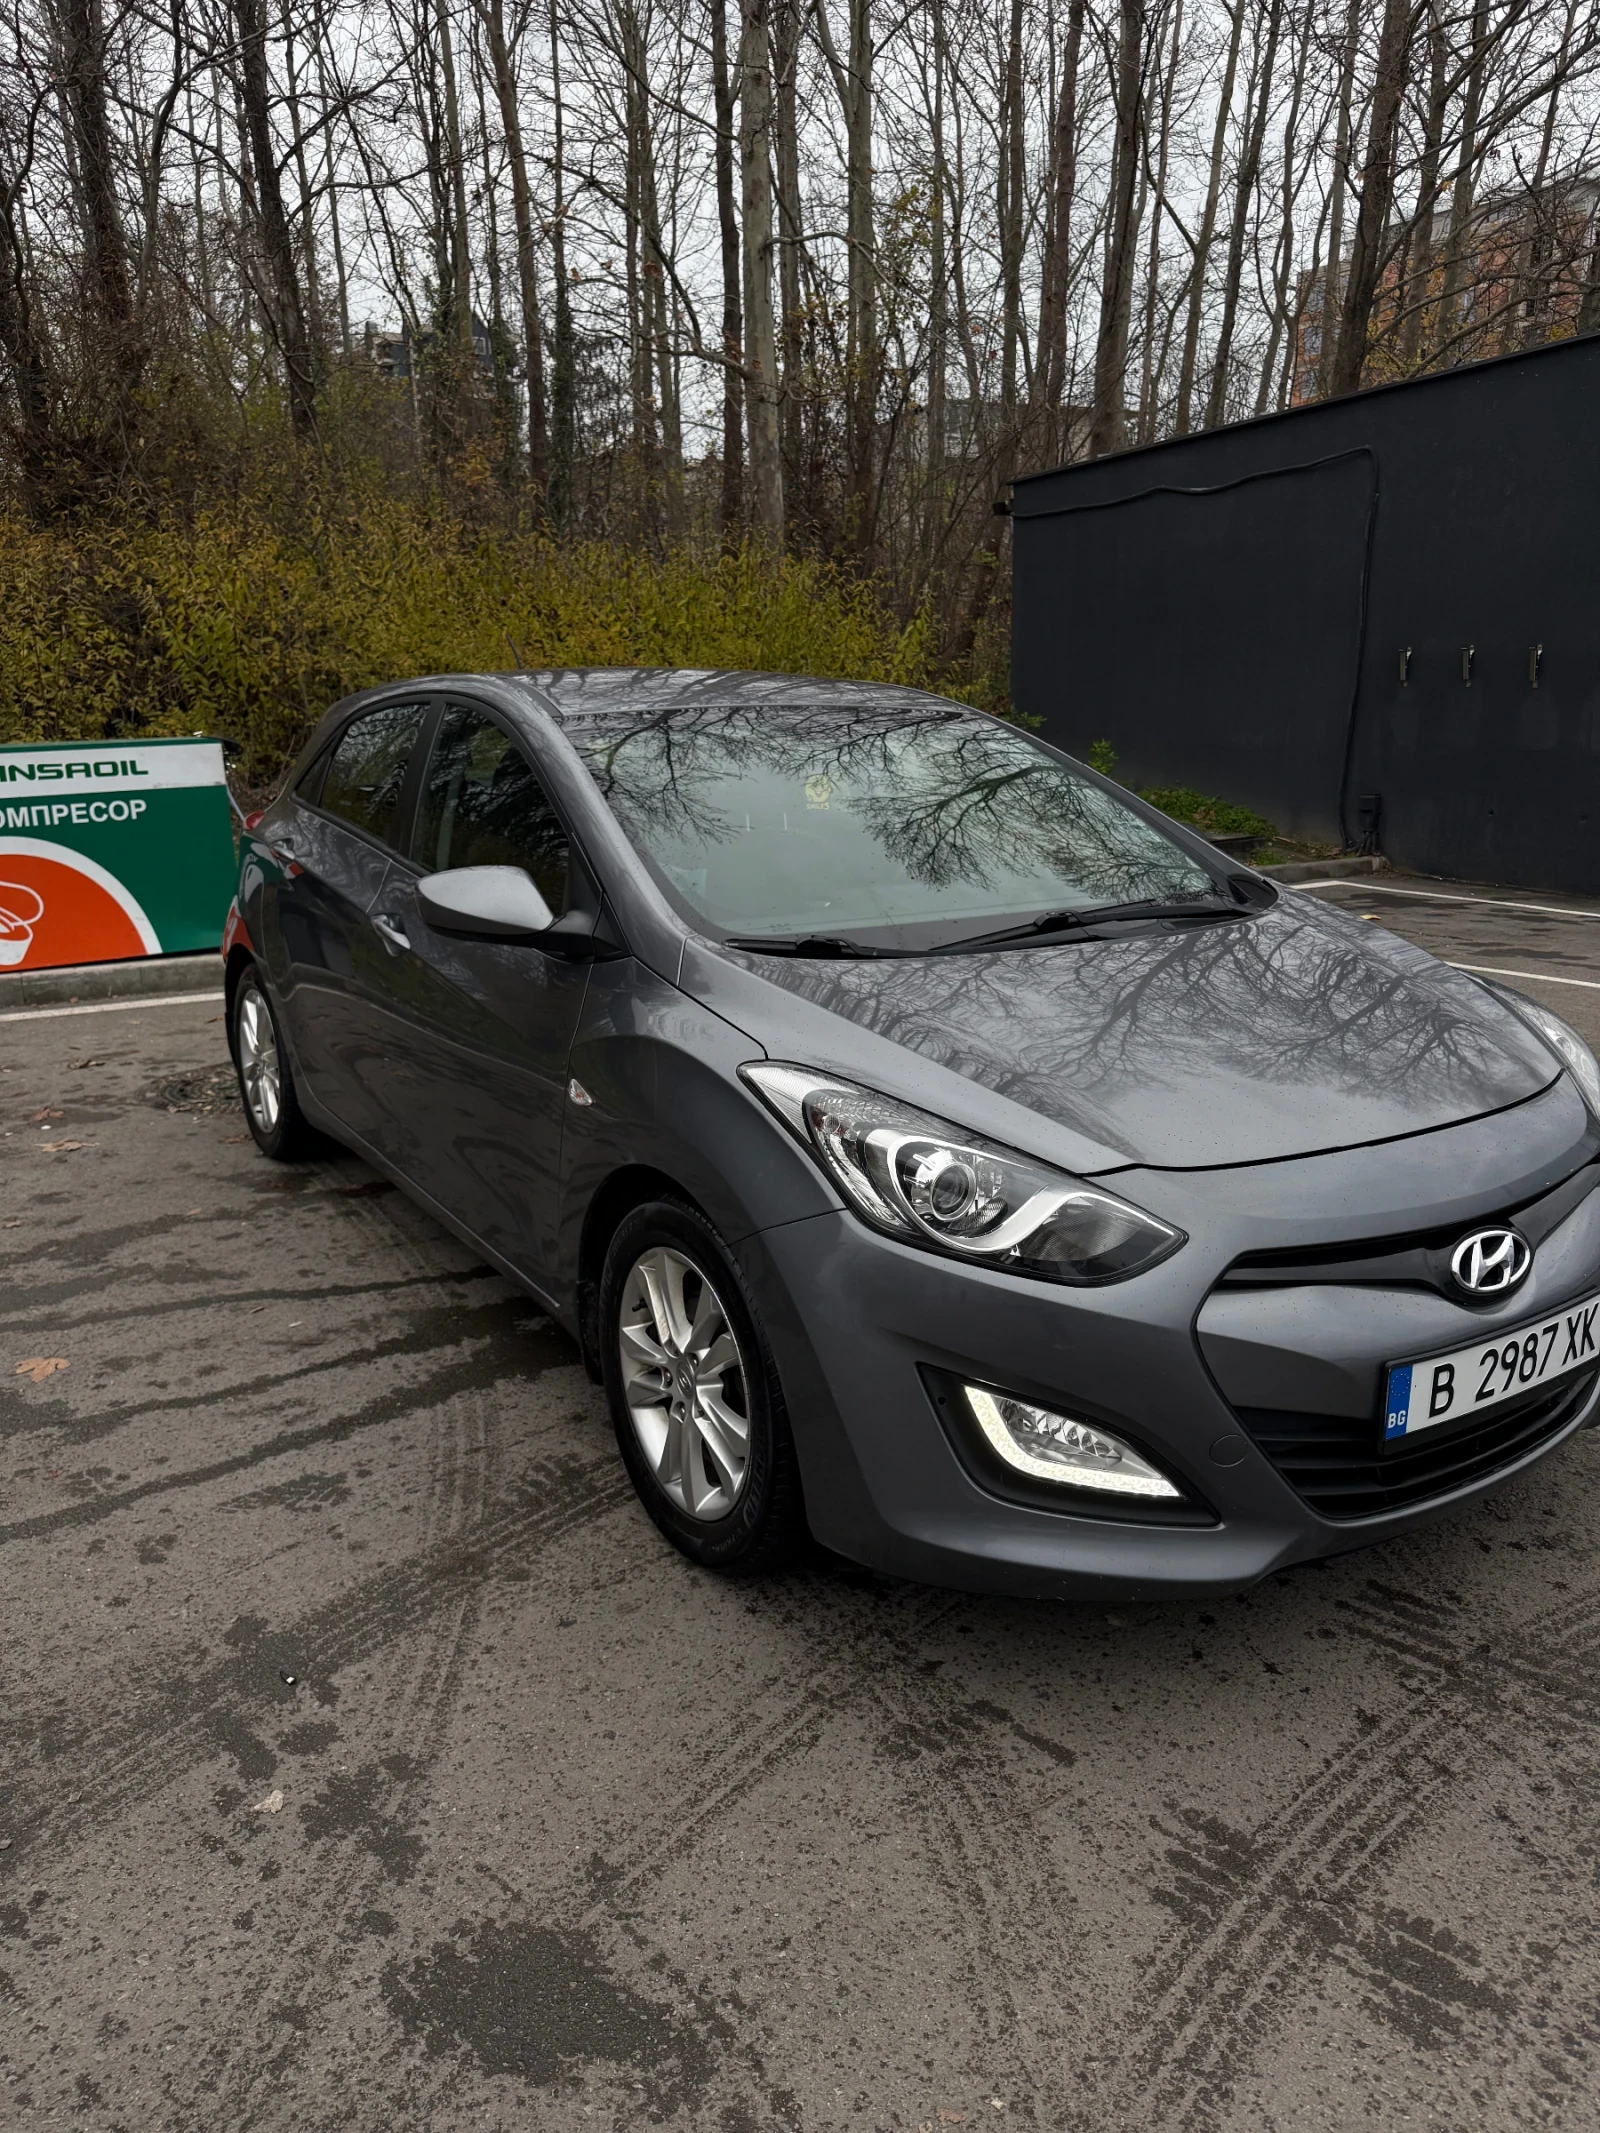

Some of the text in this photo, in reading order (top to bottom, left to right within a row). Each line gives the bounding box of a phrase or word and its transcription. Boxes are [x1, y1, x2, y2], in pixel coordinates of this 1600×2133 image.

[0, 799, 147, 829] МПРЕСОР
[1428, 1302, 1600, 1419] B 2987 XK
[1387, 1410, 1406, 1429] BG
